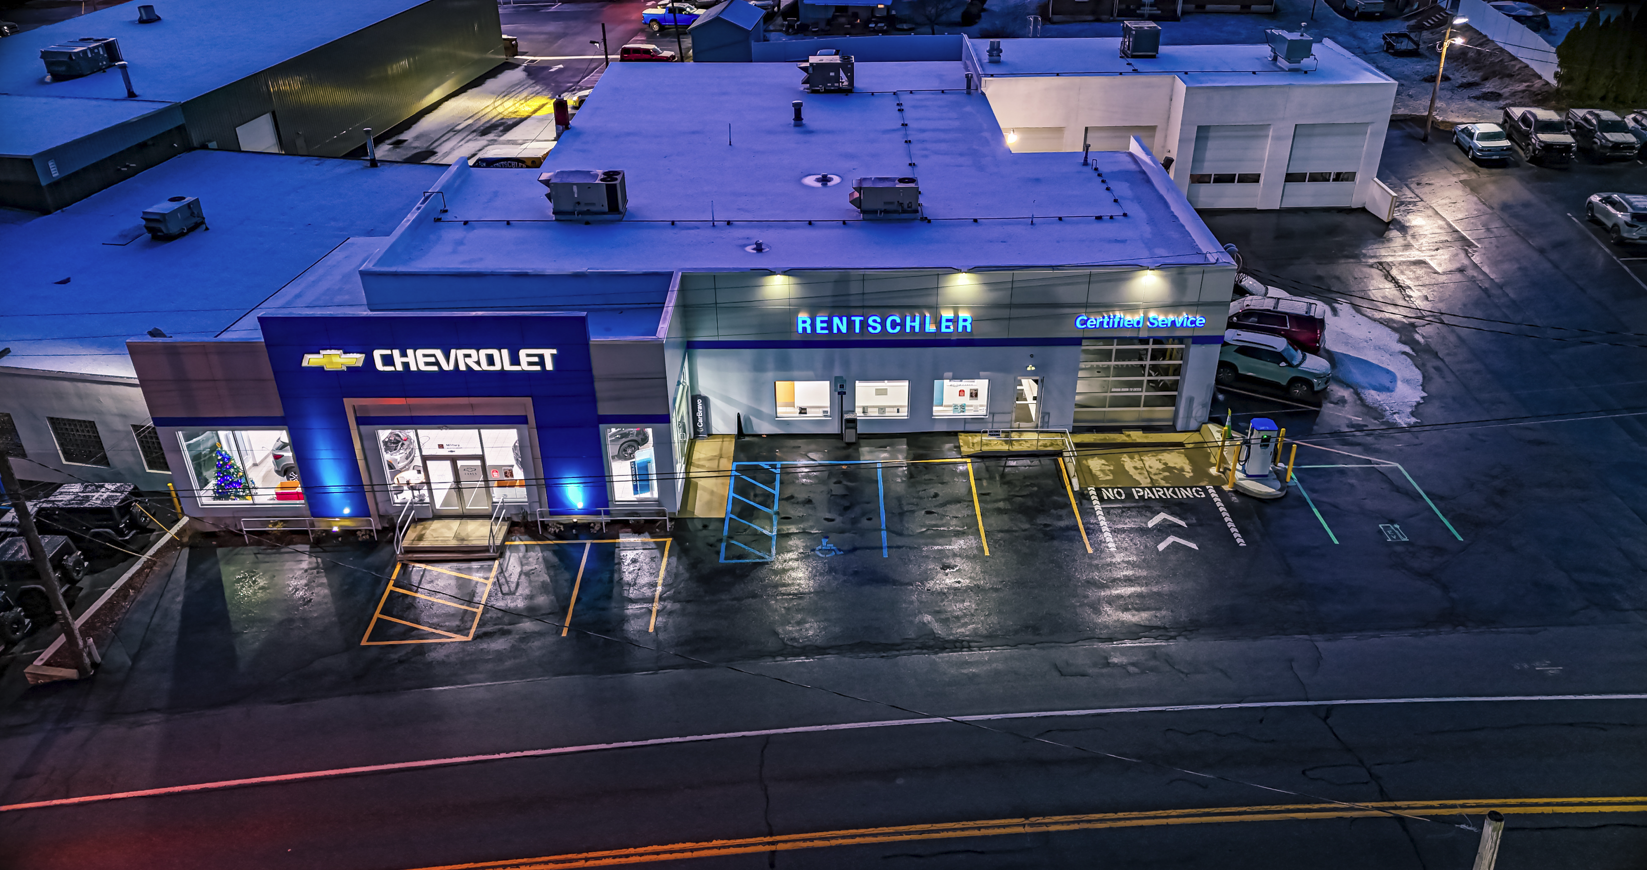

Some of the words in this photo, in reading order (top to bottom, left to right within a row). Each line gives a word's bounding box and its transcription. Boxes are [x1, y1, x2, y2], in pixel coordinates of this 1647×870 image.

[798, 315, 973, 334] RENTSCHLER
[1075, 314, 1144, 329] Certified
[1148, 313, 1206, 328] Service
[372, 348, 557, 371] CHEVROLET
[696, 399, 704, 427] CarBravo
[1101, 487, 1126, 500] NO
[1131, 487, 1206, 499] PARKING
